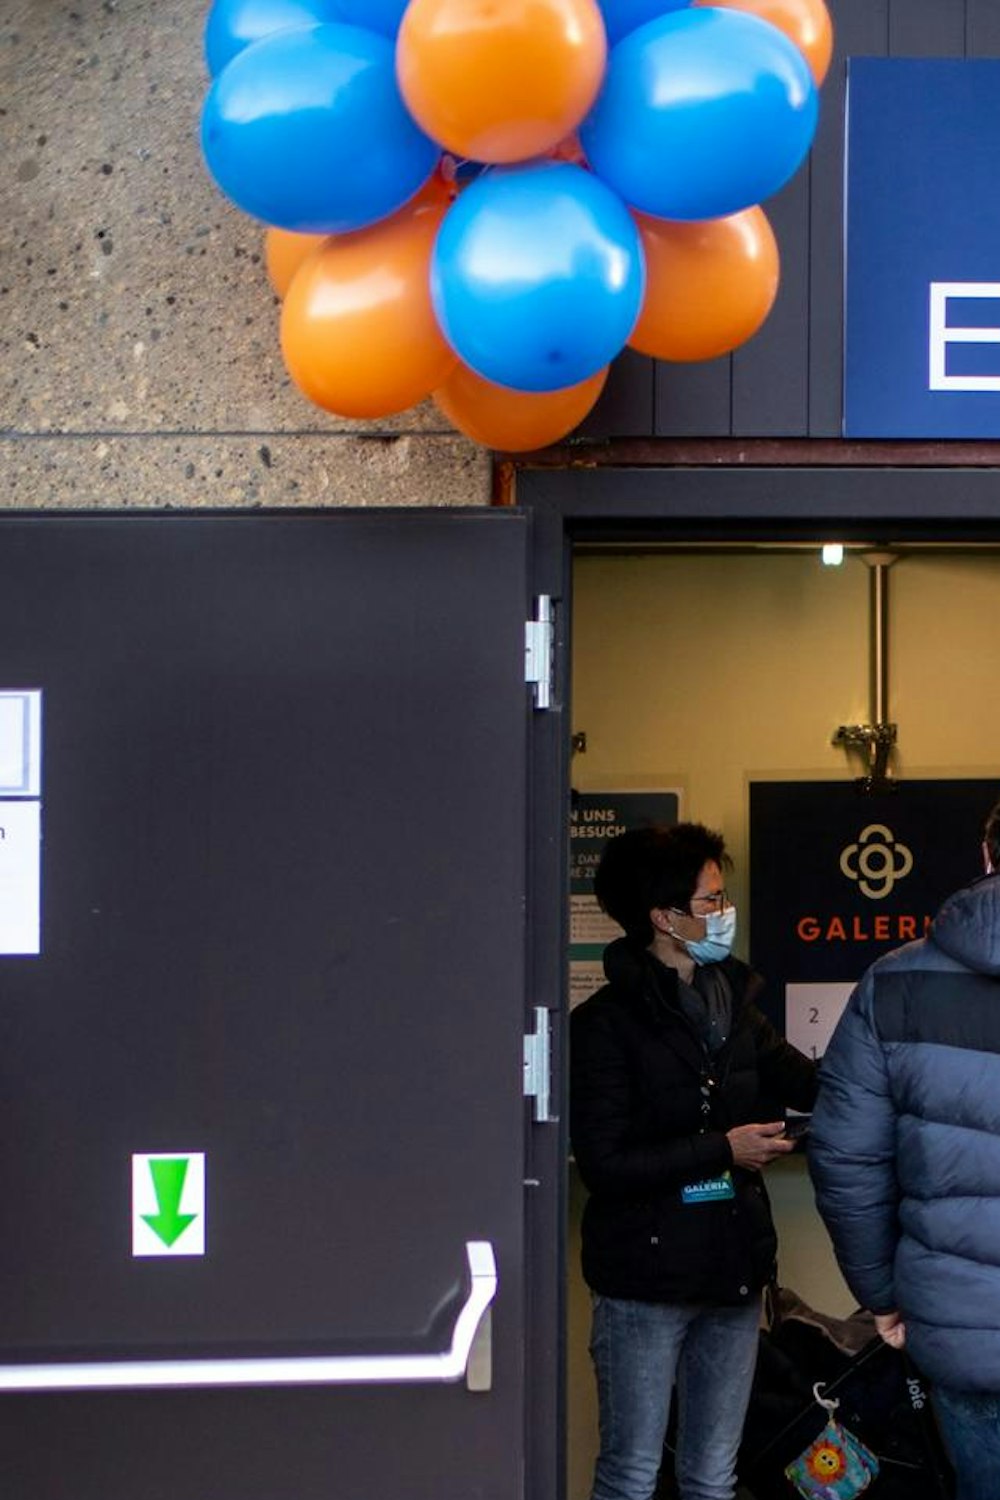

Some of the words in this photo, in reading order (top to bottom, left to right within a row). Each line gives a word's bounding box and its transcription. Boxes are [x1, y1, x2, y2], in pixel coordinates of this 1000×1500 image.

[585, 809, 616, 822] UNS
[797, 915, 931, 942] GALERI
[809, 1008, 819, 1023] 2
[684, 1181, 729, 1193] GALERIA
